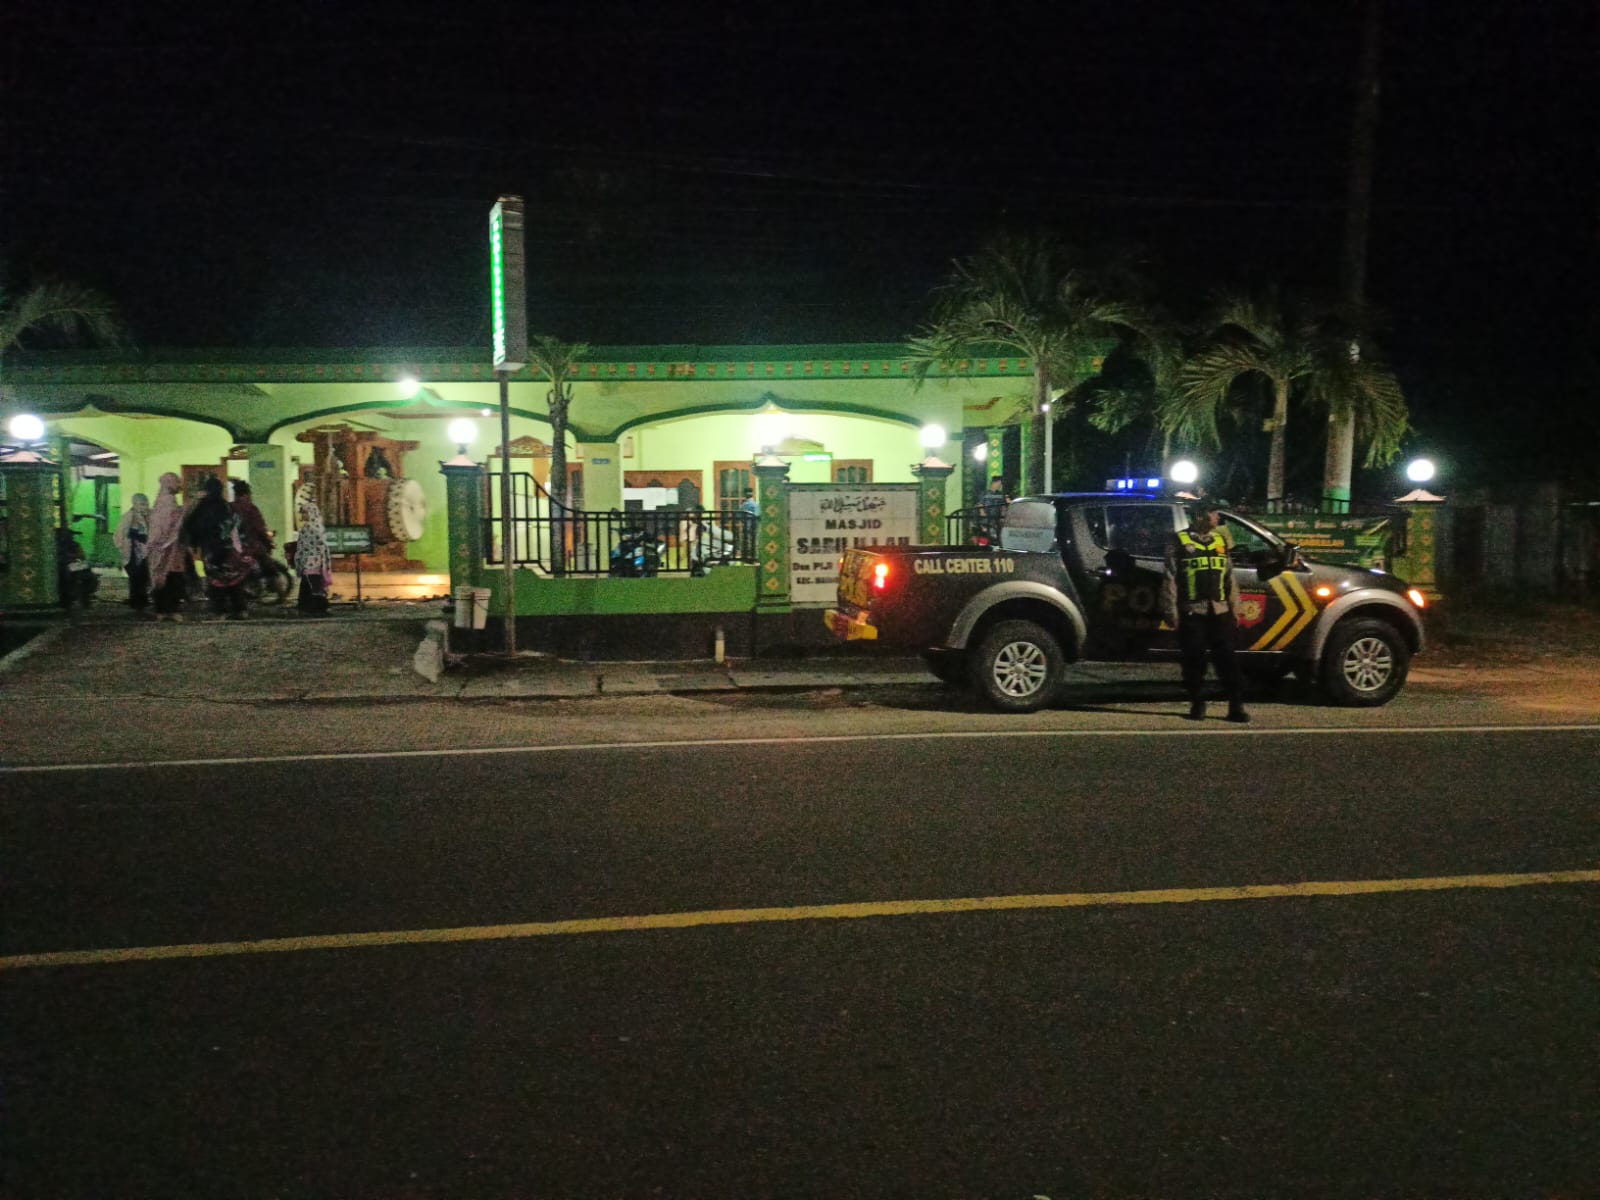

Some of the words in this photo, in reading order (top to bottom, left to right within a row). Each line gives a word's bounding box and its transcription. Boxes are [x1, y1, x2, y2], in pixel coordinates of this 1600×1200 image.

[825, 519, 882, 529] MASJID
[914, 559, 944, 574] CALL
[946, 558, 992, 574] CENTER
[993, 557, 1015, 573] 110
